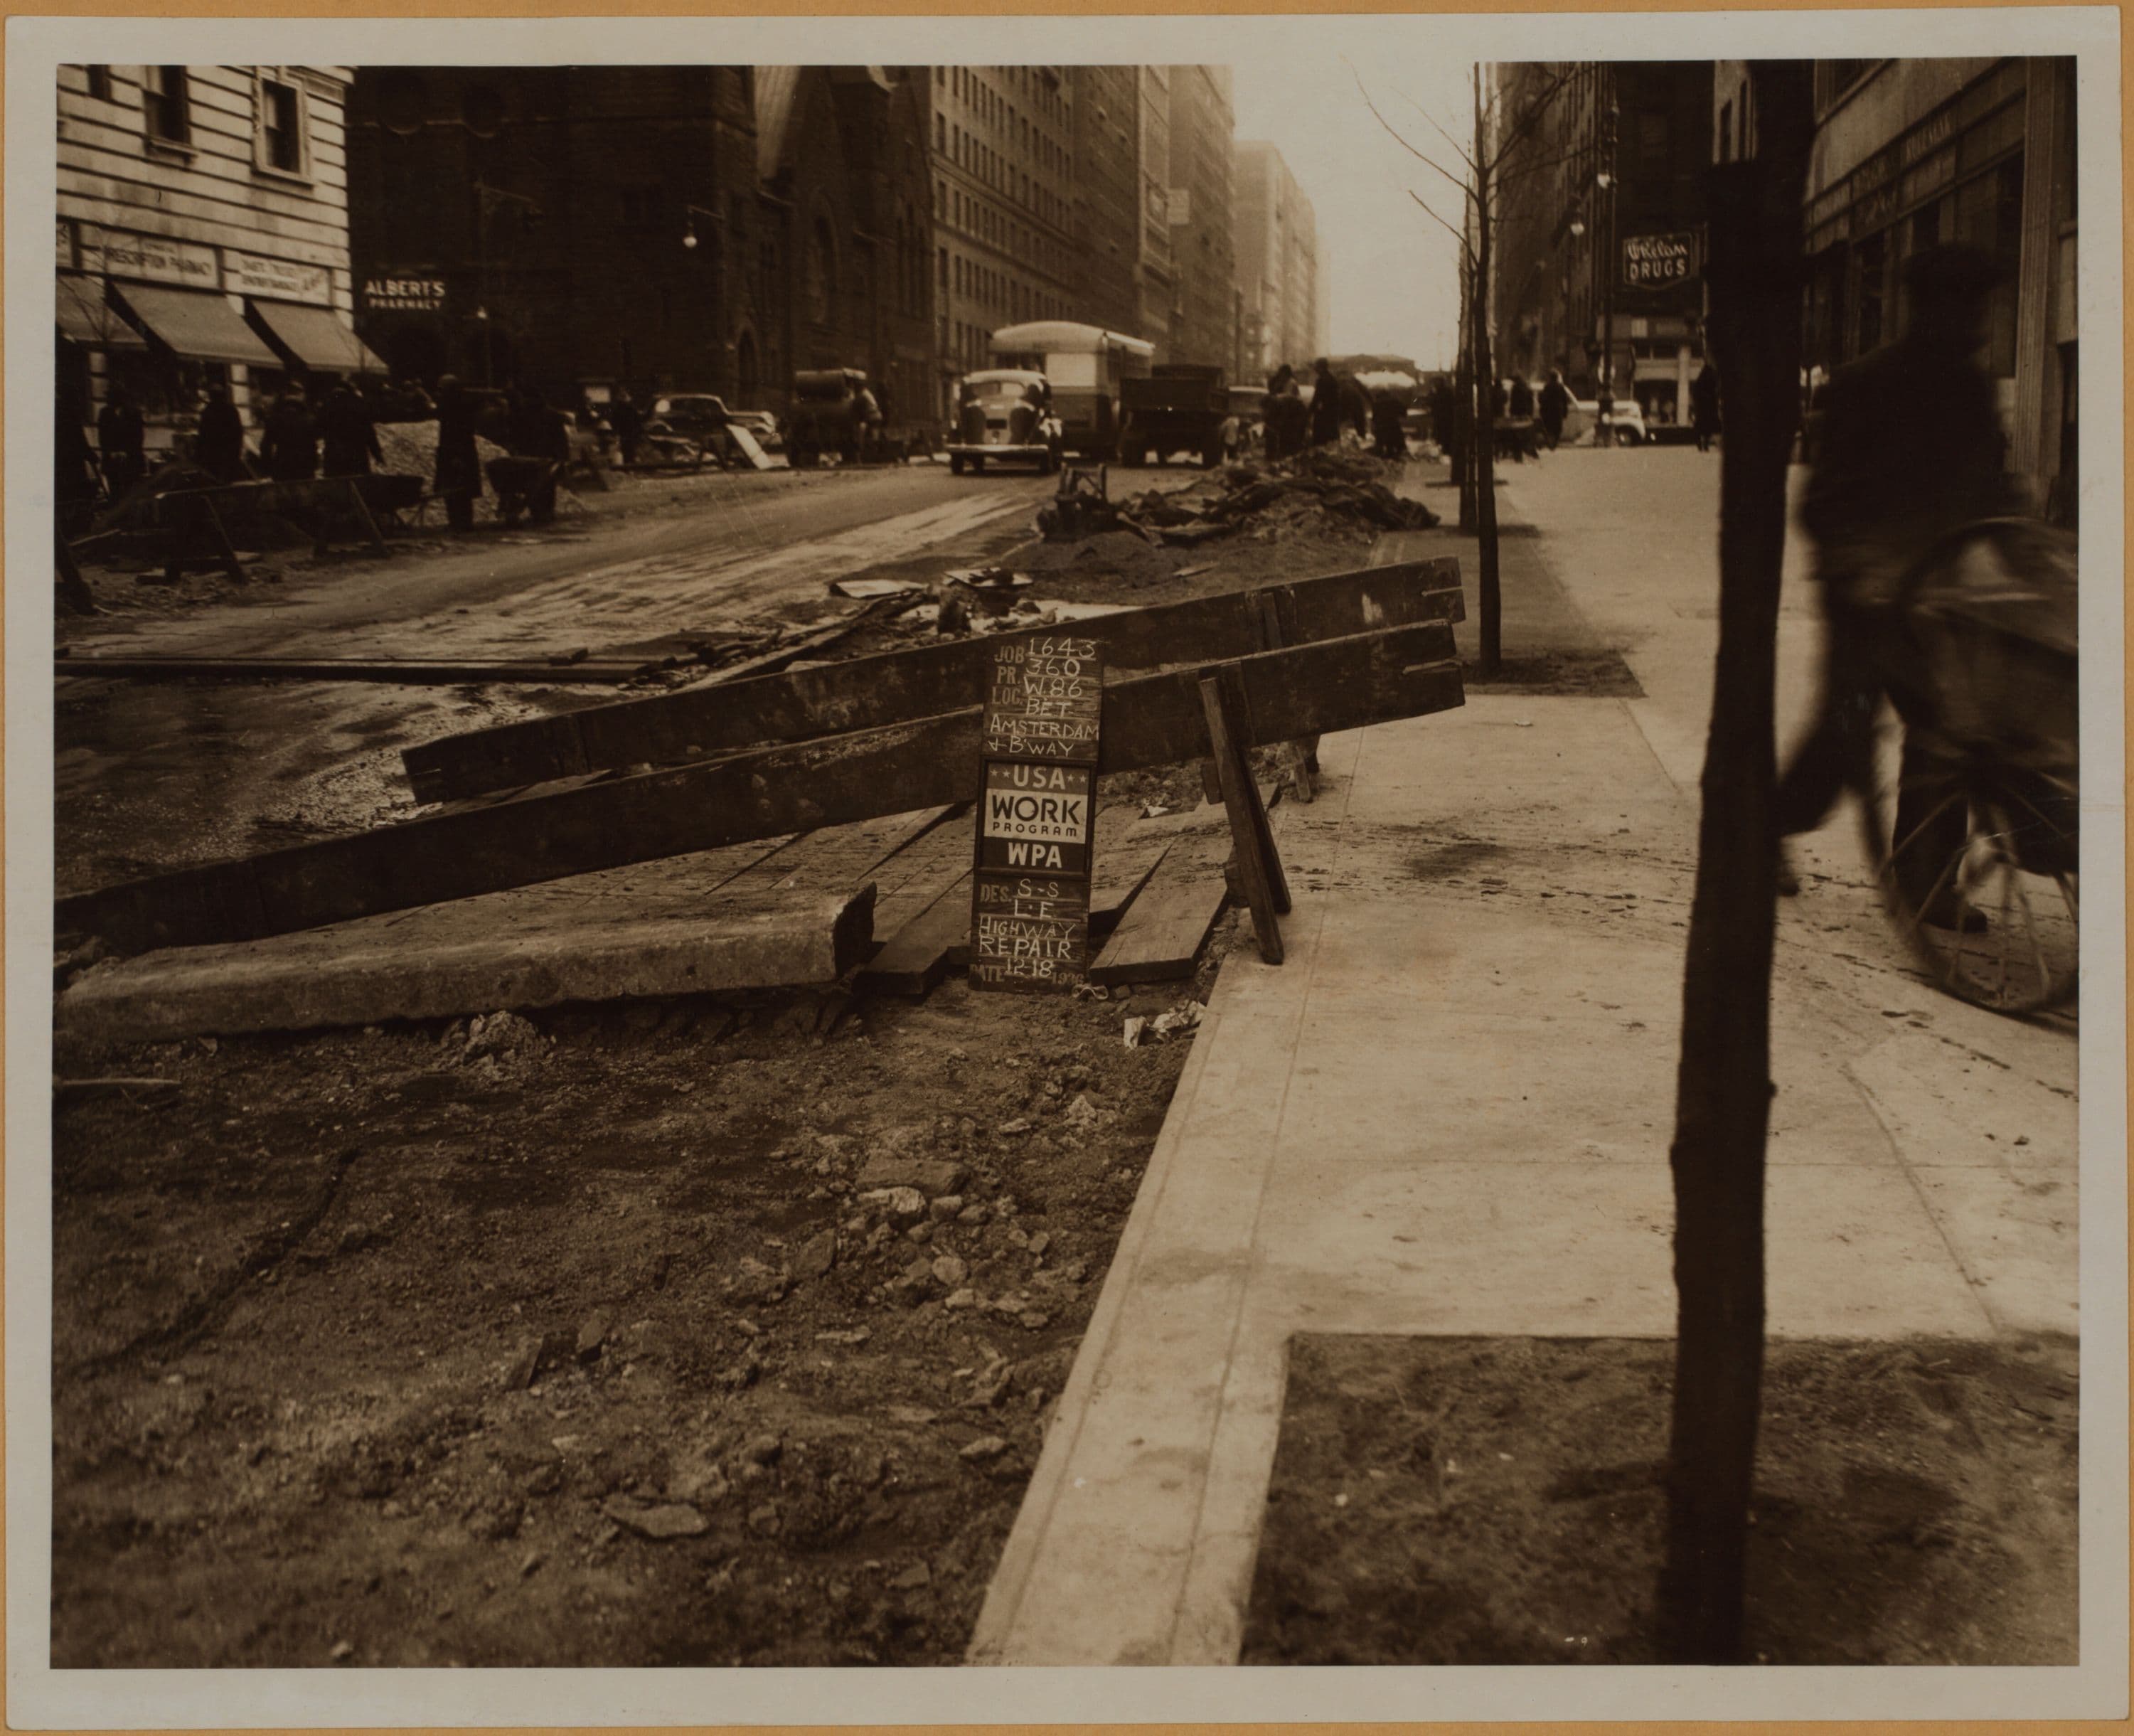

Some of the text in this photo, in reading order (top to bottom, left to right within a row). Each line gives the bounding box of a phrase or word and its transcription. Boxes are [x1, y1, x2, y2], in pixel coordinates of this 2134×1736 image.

[1629, 258, 1686, 280] DRUGS
[364, 279, 446, 297] ALBERT'S
[370, 298, 441, 311] PHARMACY
[993, 637, 1097, 664] JOB 1643
[1025, 657, 1081, 677] 360
[1013, 764, 1066, 790] USA
[992, 794, 1082, 825] WORK
[992, 821, 1077, 837] PROGRAM
[1008, 841, 1062, 868] WPA
[978, 936, 1072, 959] REPAIR
